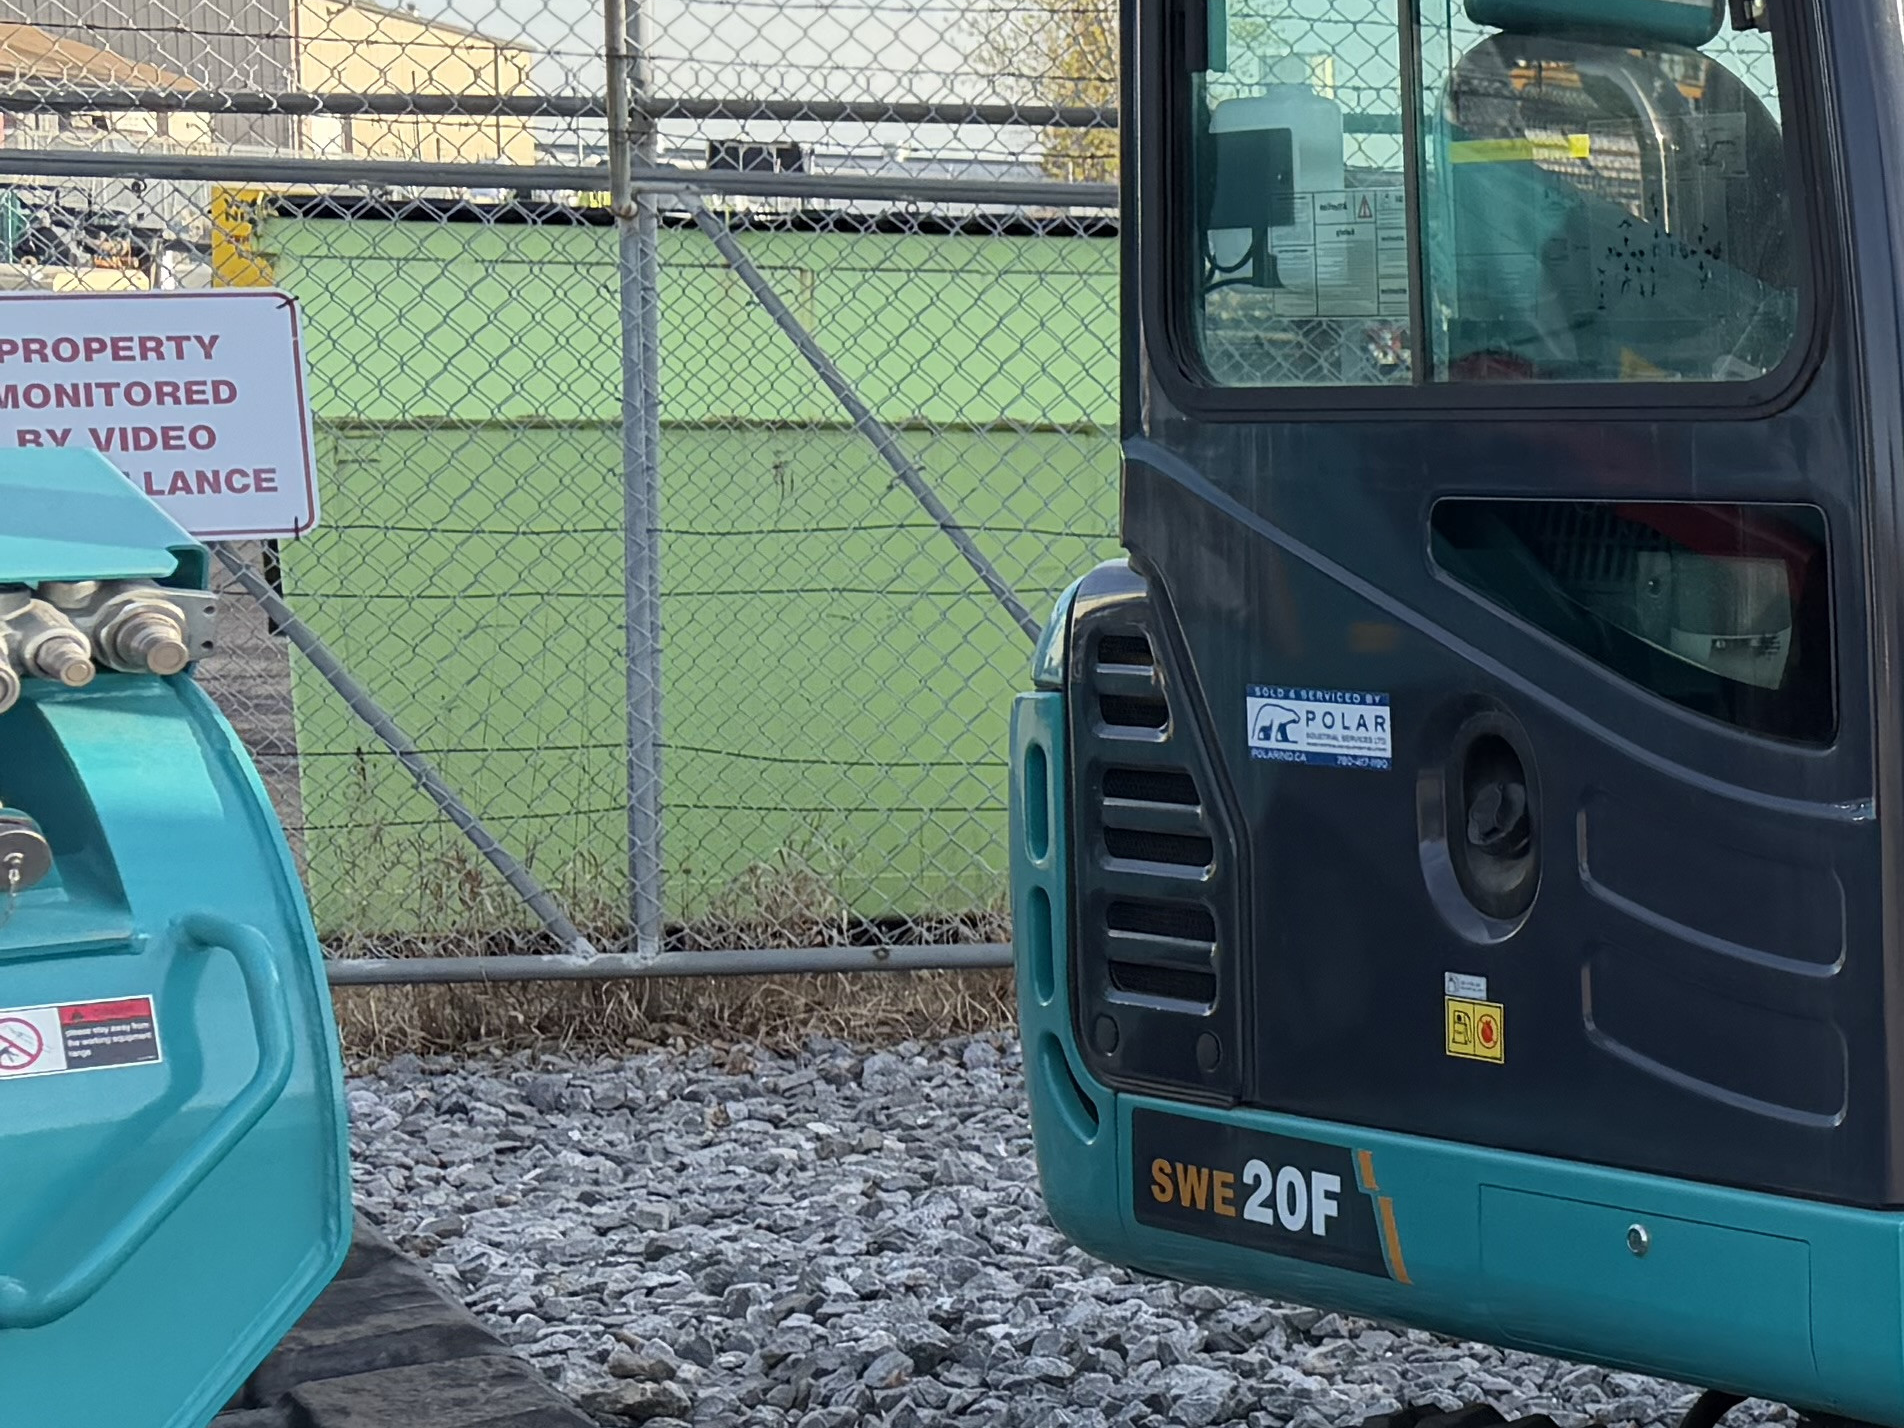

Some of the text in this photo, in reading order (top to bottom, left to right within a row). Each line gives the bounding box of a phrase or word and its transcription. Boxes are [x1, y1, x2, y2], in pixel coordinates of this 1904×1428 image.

[0, 335, 220, 363] PROPERTY
[88, 424, 217, 452] VIDEO
[1254, 686, 1285, 698] SOLD
[1300, 689, 1361, 704] SERVICED
[1305, 709, 1387, 733] POLAR
